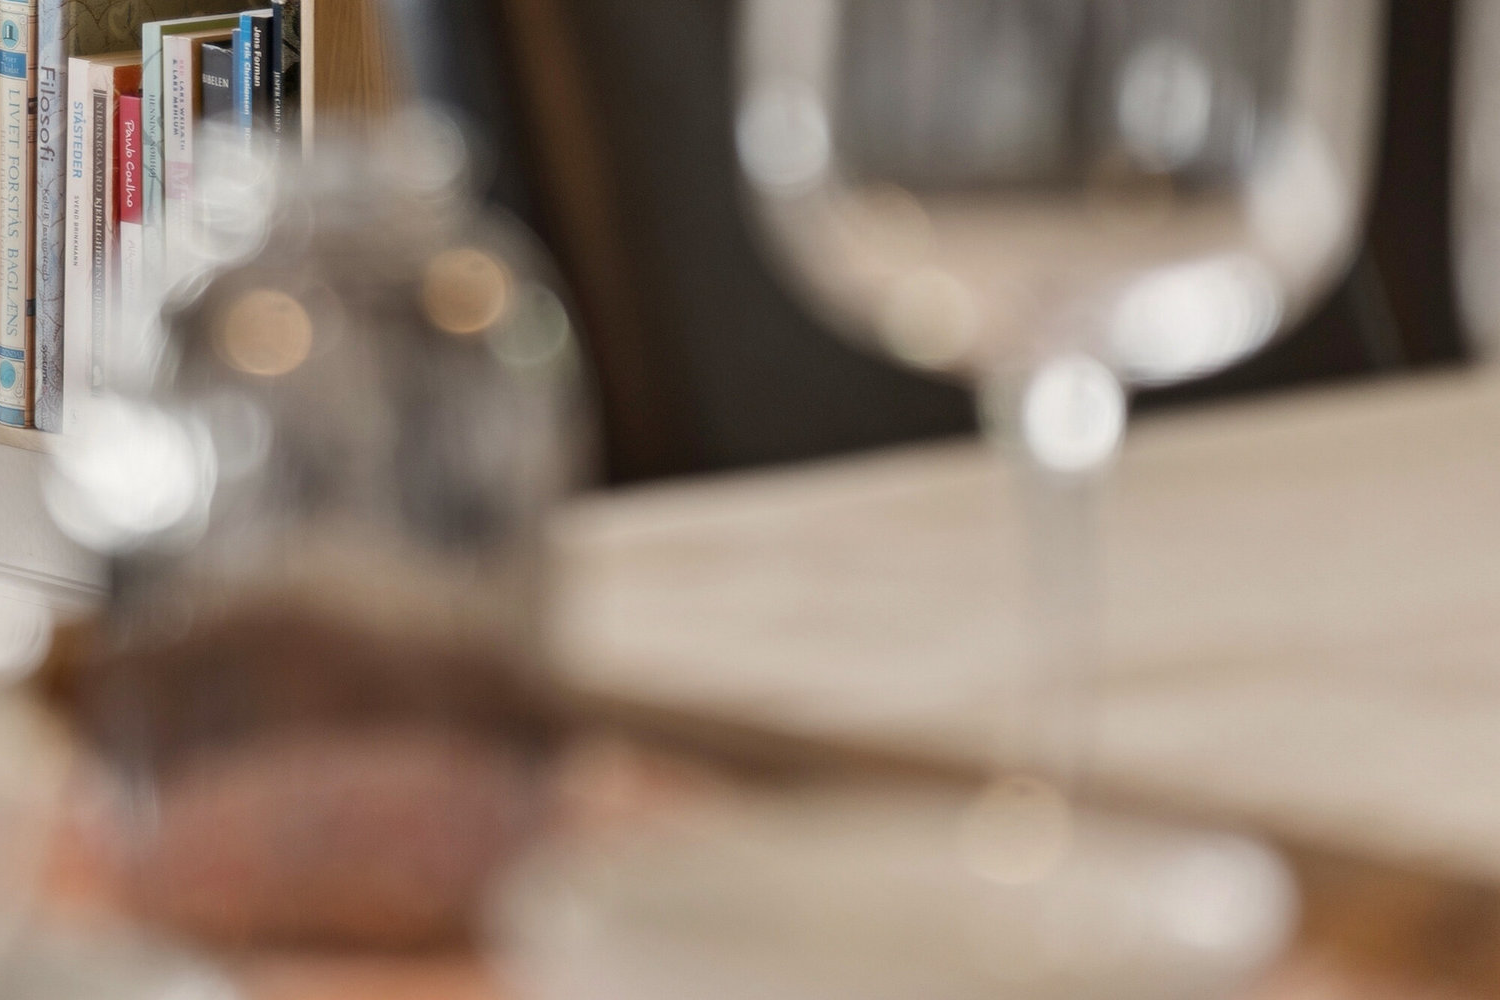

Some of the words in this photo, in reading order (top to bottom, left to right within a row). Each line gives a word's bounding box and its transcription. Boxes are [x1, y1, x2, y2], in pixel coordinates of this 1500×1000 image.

[254, 26, 262, 49] Jens
[202, 73, 229, 88] BIBELEN
[253, 50, 262, 87] Forman
[8, 89, 21, 147] LIVET
[39, 66, 56, 162] Filosofi
[72, 101, 86, 178] STÅSTEDER
[124, 119, 136, 158] Paulo
[8, 155, 22, 238] FORSTÅS
[125, 161, 136, 208] Coelho
[6, 248, 19, 337] BAGLÆNS
[40, 344, 48, 384] systime
